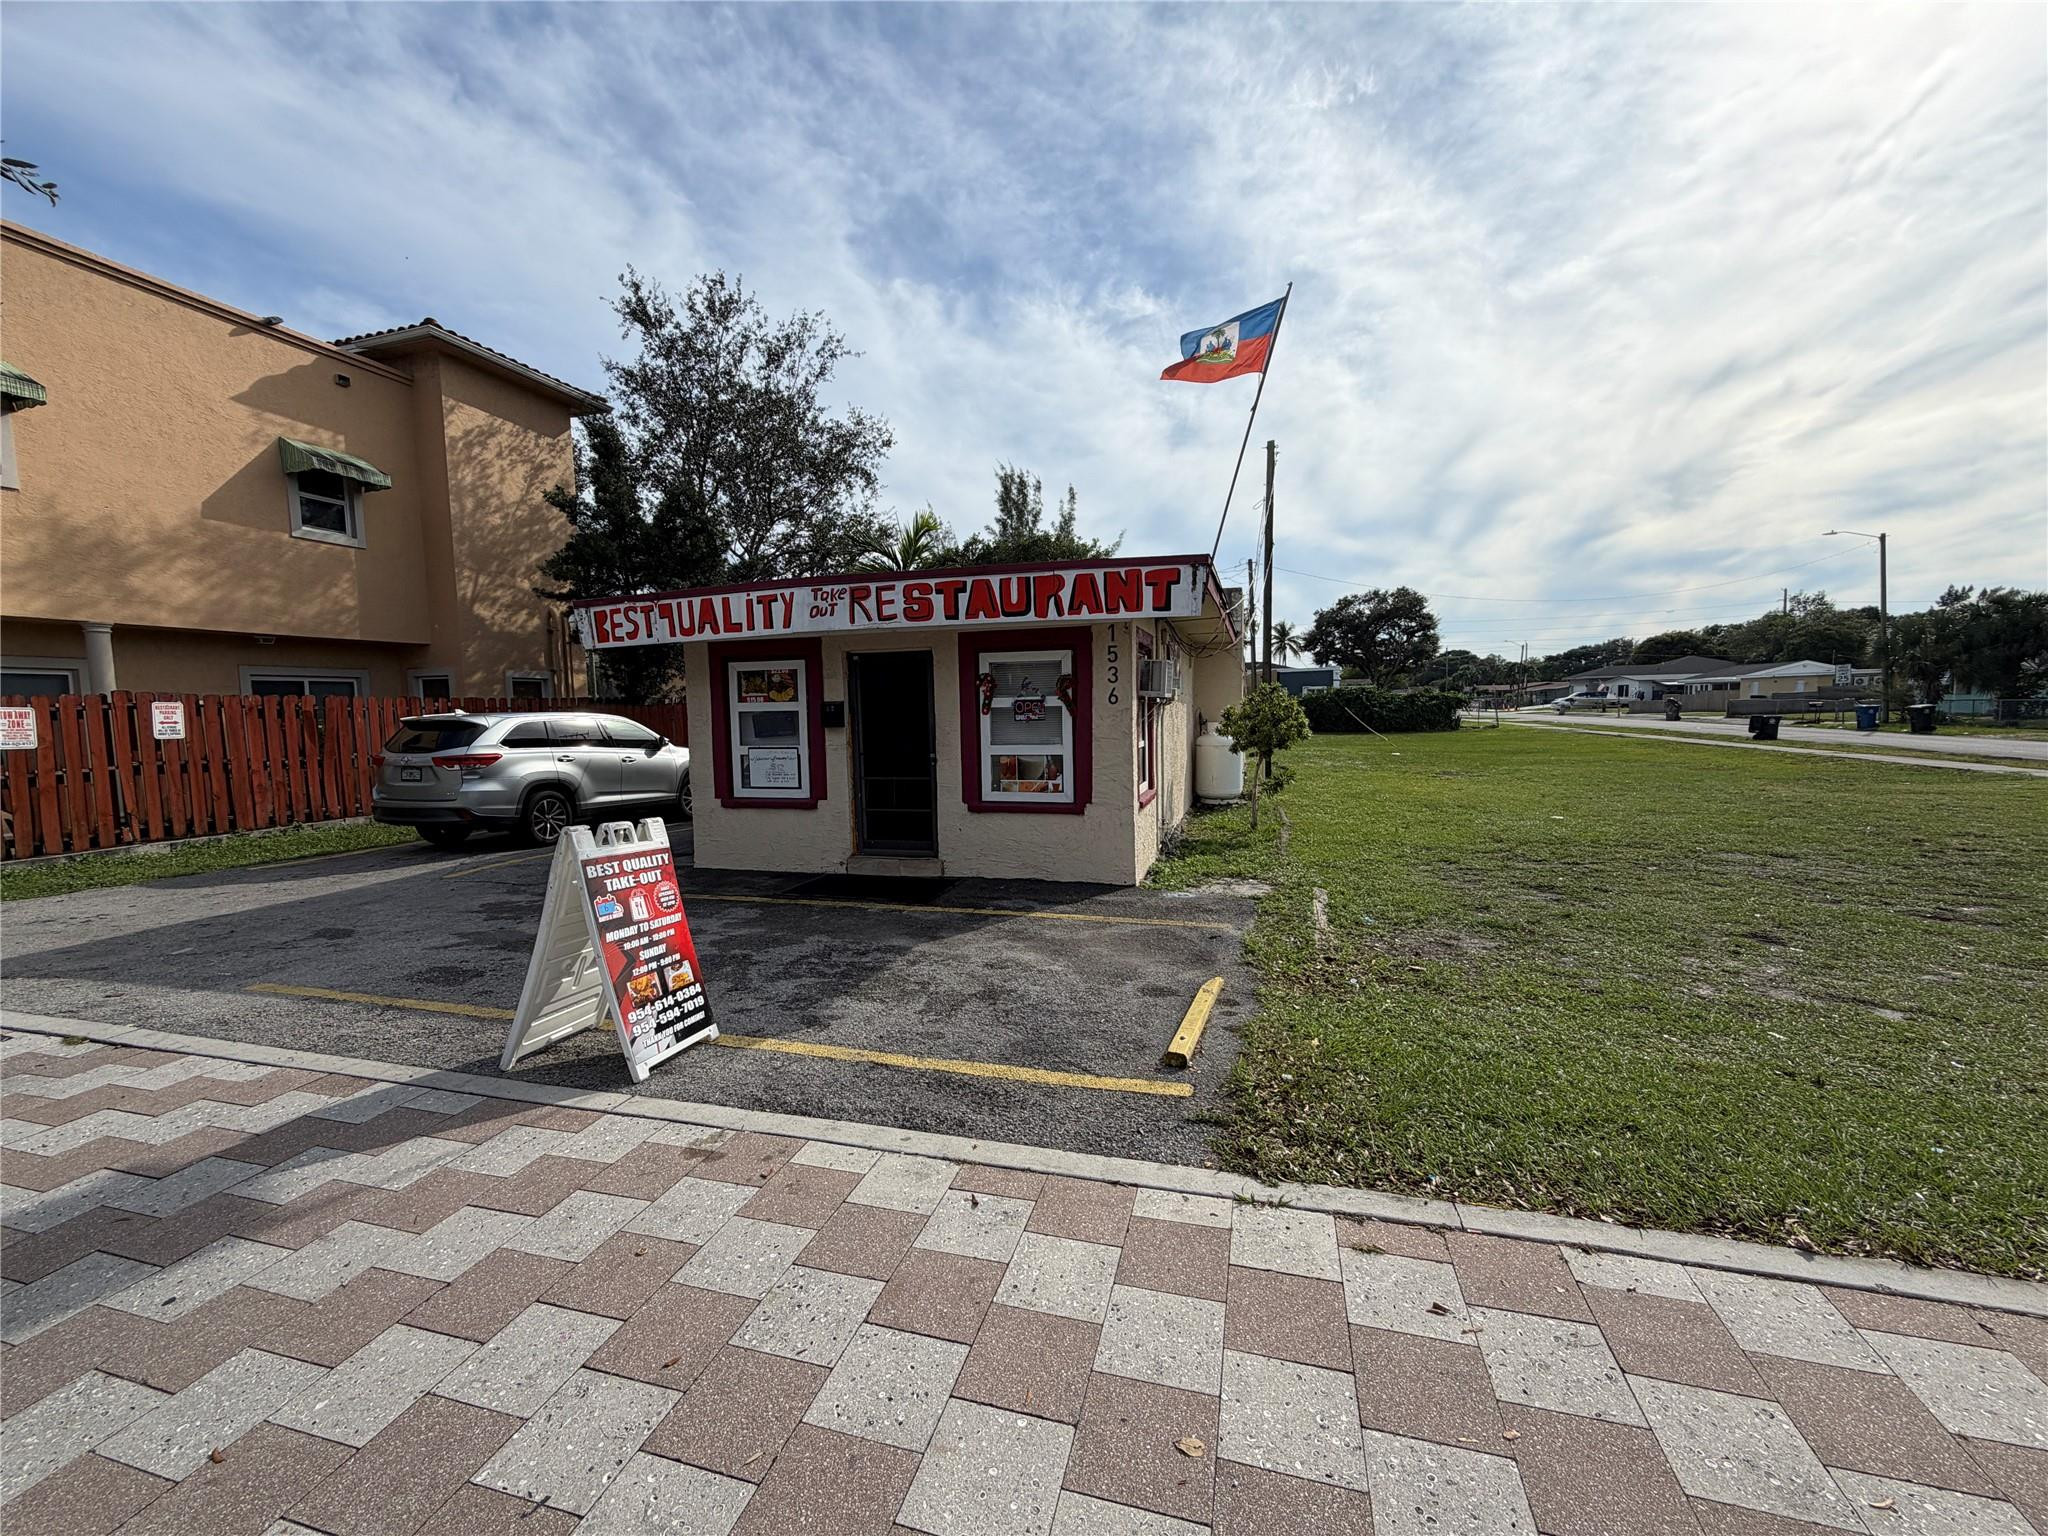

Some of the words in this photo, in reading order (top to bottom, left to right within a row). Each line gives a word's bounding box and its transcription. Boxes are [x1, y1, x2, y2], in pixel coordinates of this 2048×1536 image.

[849, 567, 1181, 625] RESTAURANT
[593, 604, 655, 644] BEST
[1107, 623, 1119, 705] 1536
[7, 719, 25, 728] ZONE
[14, 711, 30, 719] AWAY
[586, 861, 620, 878] BEST
[622, 853, 669, 872] QUALITY
[603, 869, 662, 892] TAKE-OUT
[605, 924, 639, 943] MONDAY
[639, 921, 649, 933] TO
[649, 912, 682, 930] SATURDAY
[639, 936, 650, 946] AM
[666, 928, 675, 937] PM
[639, 943, 667, 961] SUNDAY
[648, 961, 658, 971] PM
[672, 952, 681, 961] PM
[627, 982, 702, 1024] 954-614-0384
[632, 995, 705, 1037] 954-594-7019
[662, 1026, 673, 1038] YOU
[673, 1021, 684, 1032] FOR
